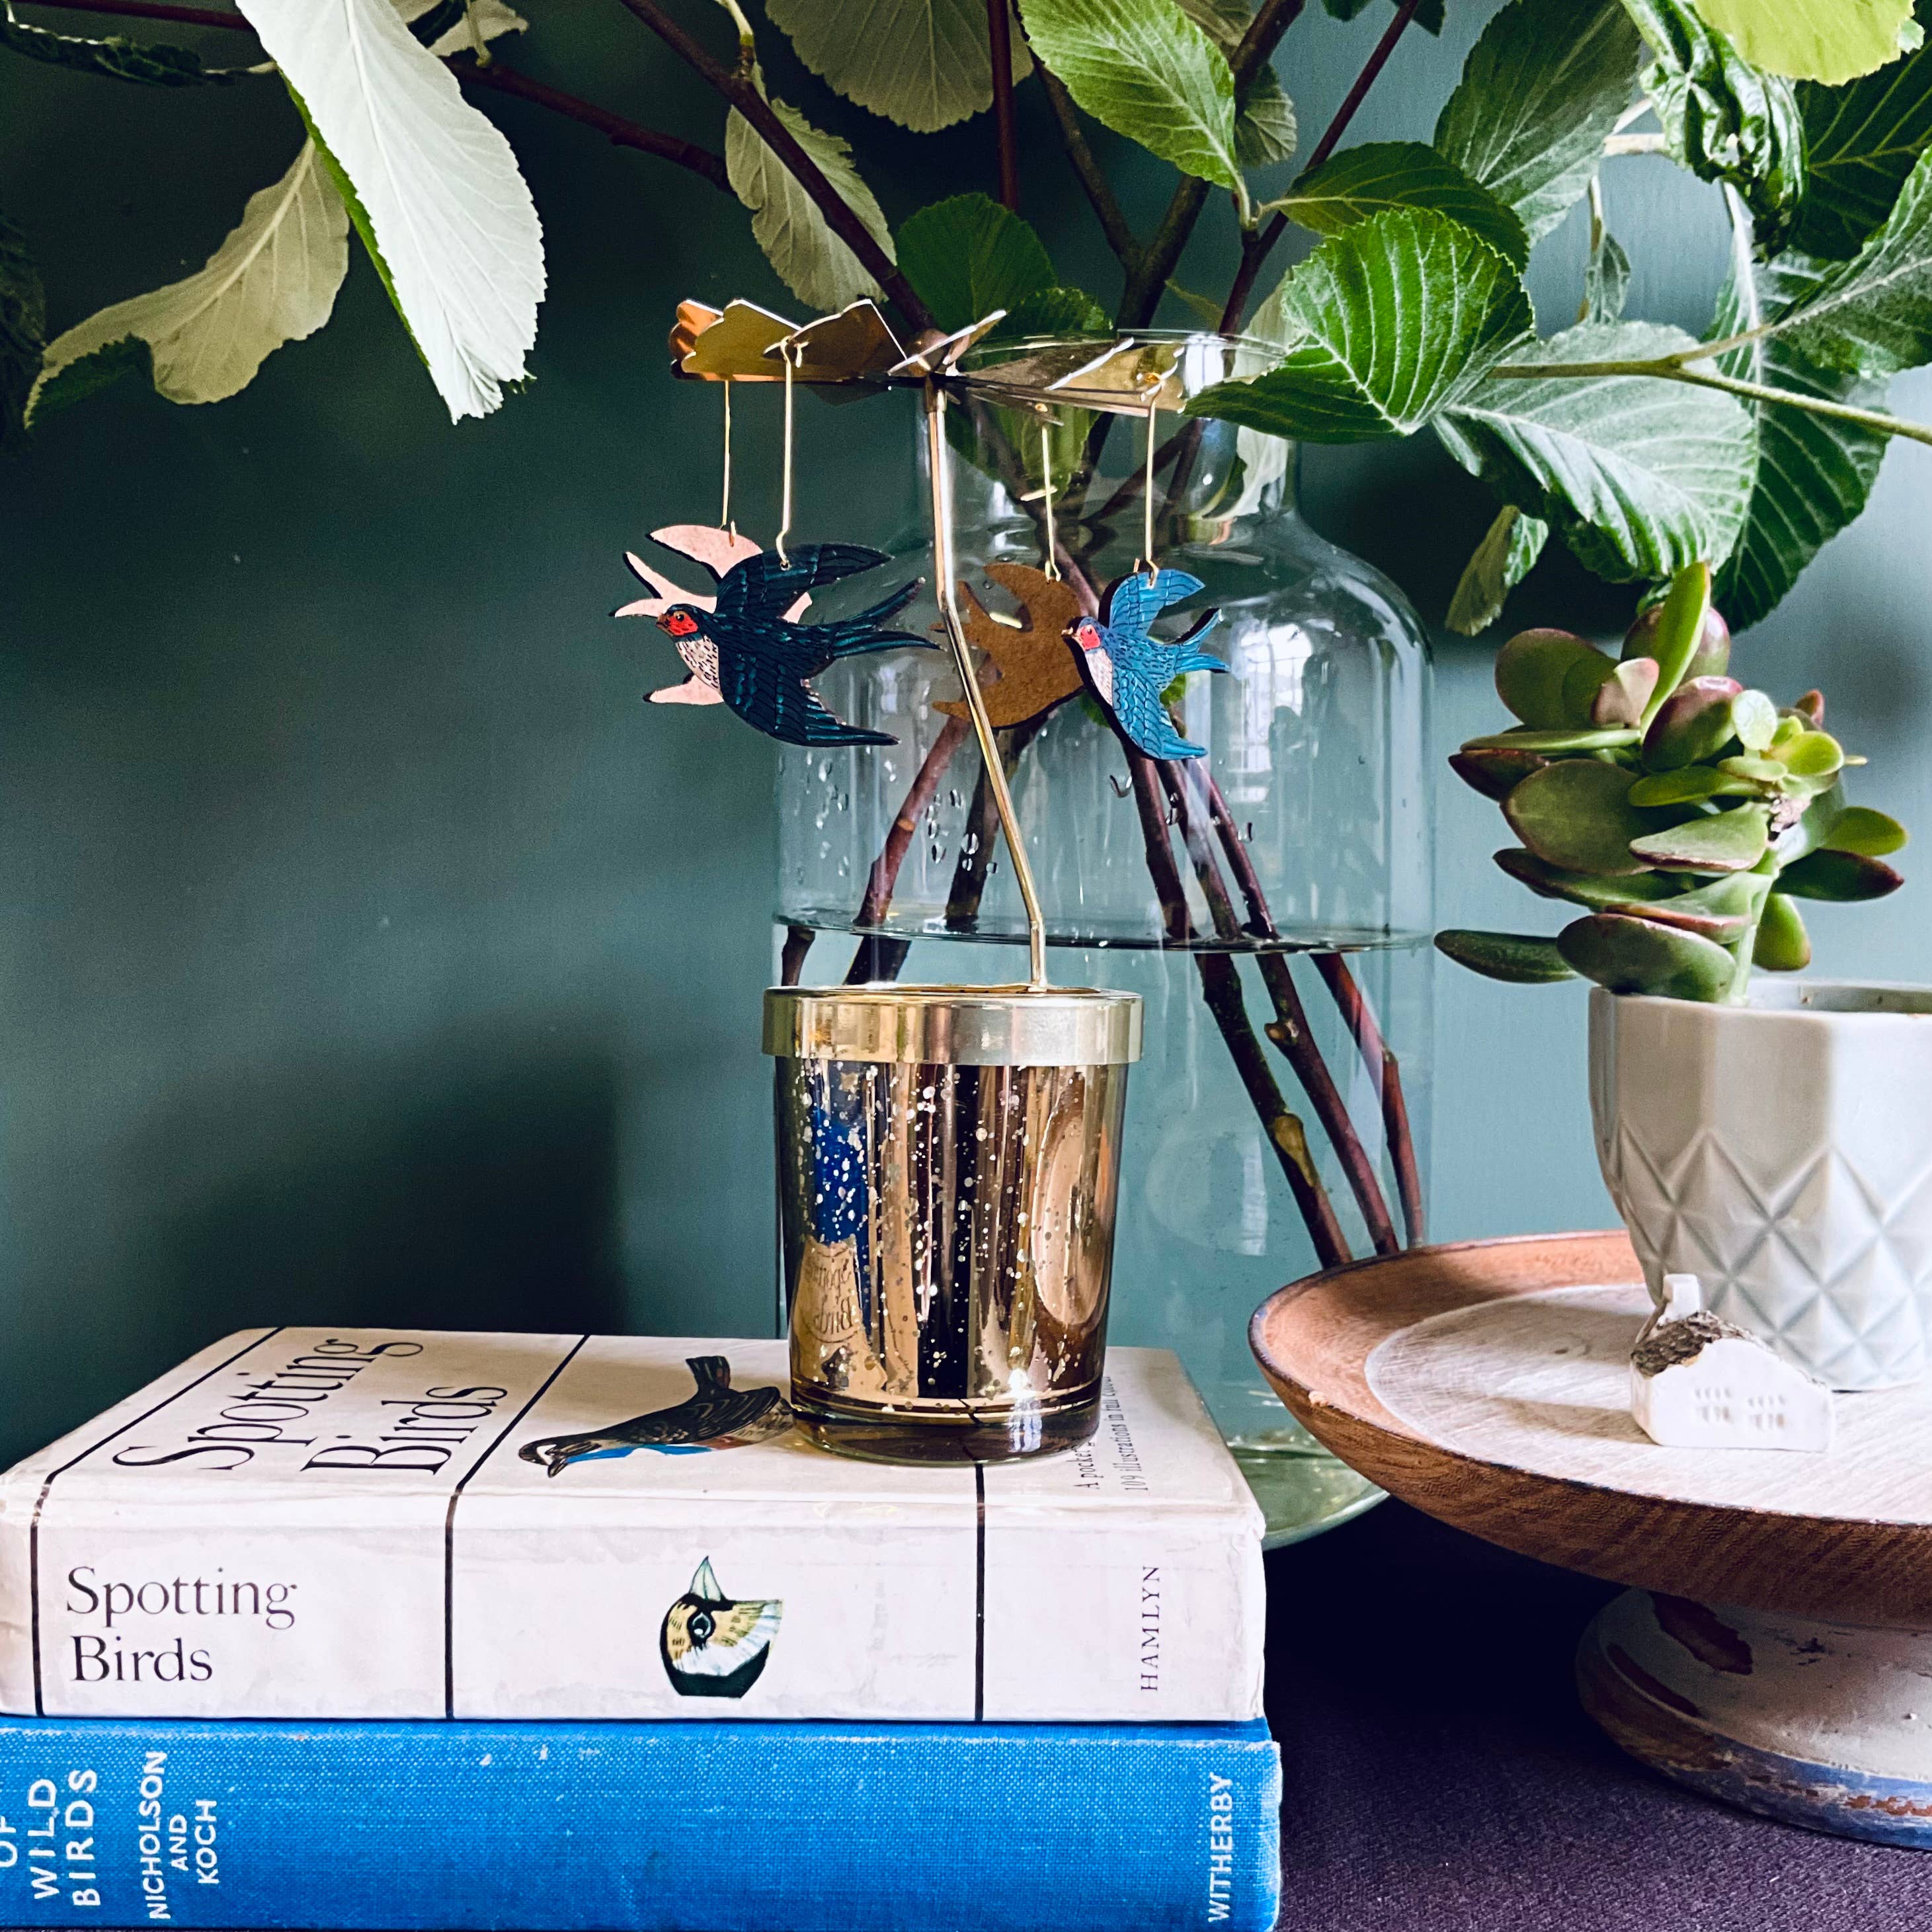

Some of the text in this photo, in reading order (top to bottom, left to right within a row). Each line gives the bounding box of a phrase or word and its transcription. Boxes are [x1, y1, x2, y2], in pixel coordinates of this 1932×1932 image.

[112, 1338, 424, 1470] Spotting
[300, 1386, 508, 1476] Birds
[1109, 1424, 1142, 1472] illustrations
[1120, 1474, 1148, 1491] 109
[67, 1565, 298, 1630] Spotting
[1141, 1566, 1160, 1692] HAMLYN
[71, 1634, 214, 1683] Birds
[27, 1778, 60, 1900] WILD
[65, 1769, 101, 1906] BIRDS
[138, 1751, 171, 1919] NICHOLSON
[169, 1814, 189, 1871] AND
[194, 1799, 220, 1884] KOCH
[1208, 1772, 1233, 1923] WITHERBY
